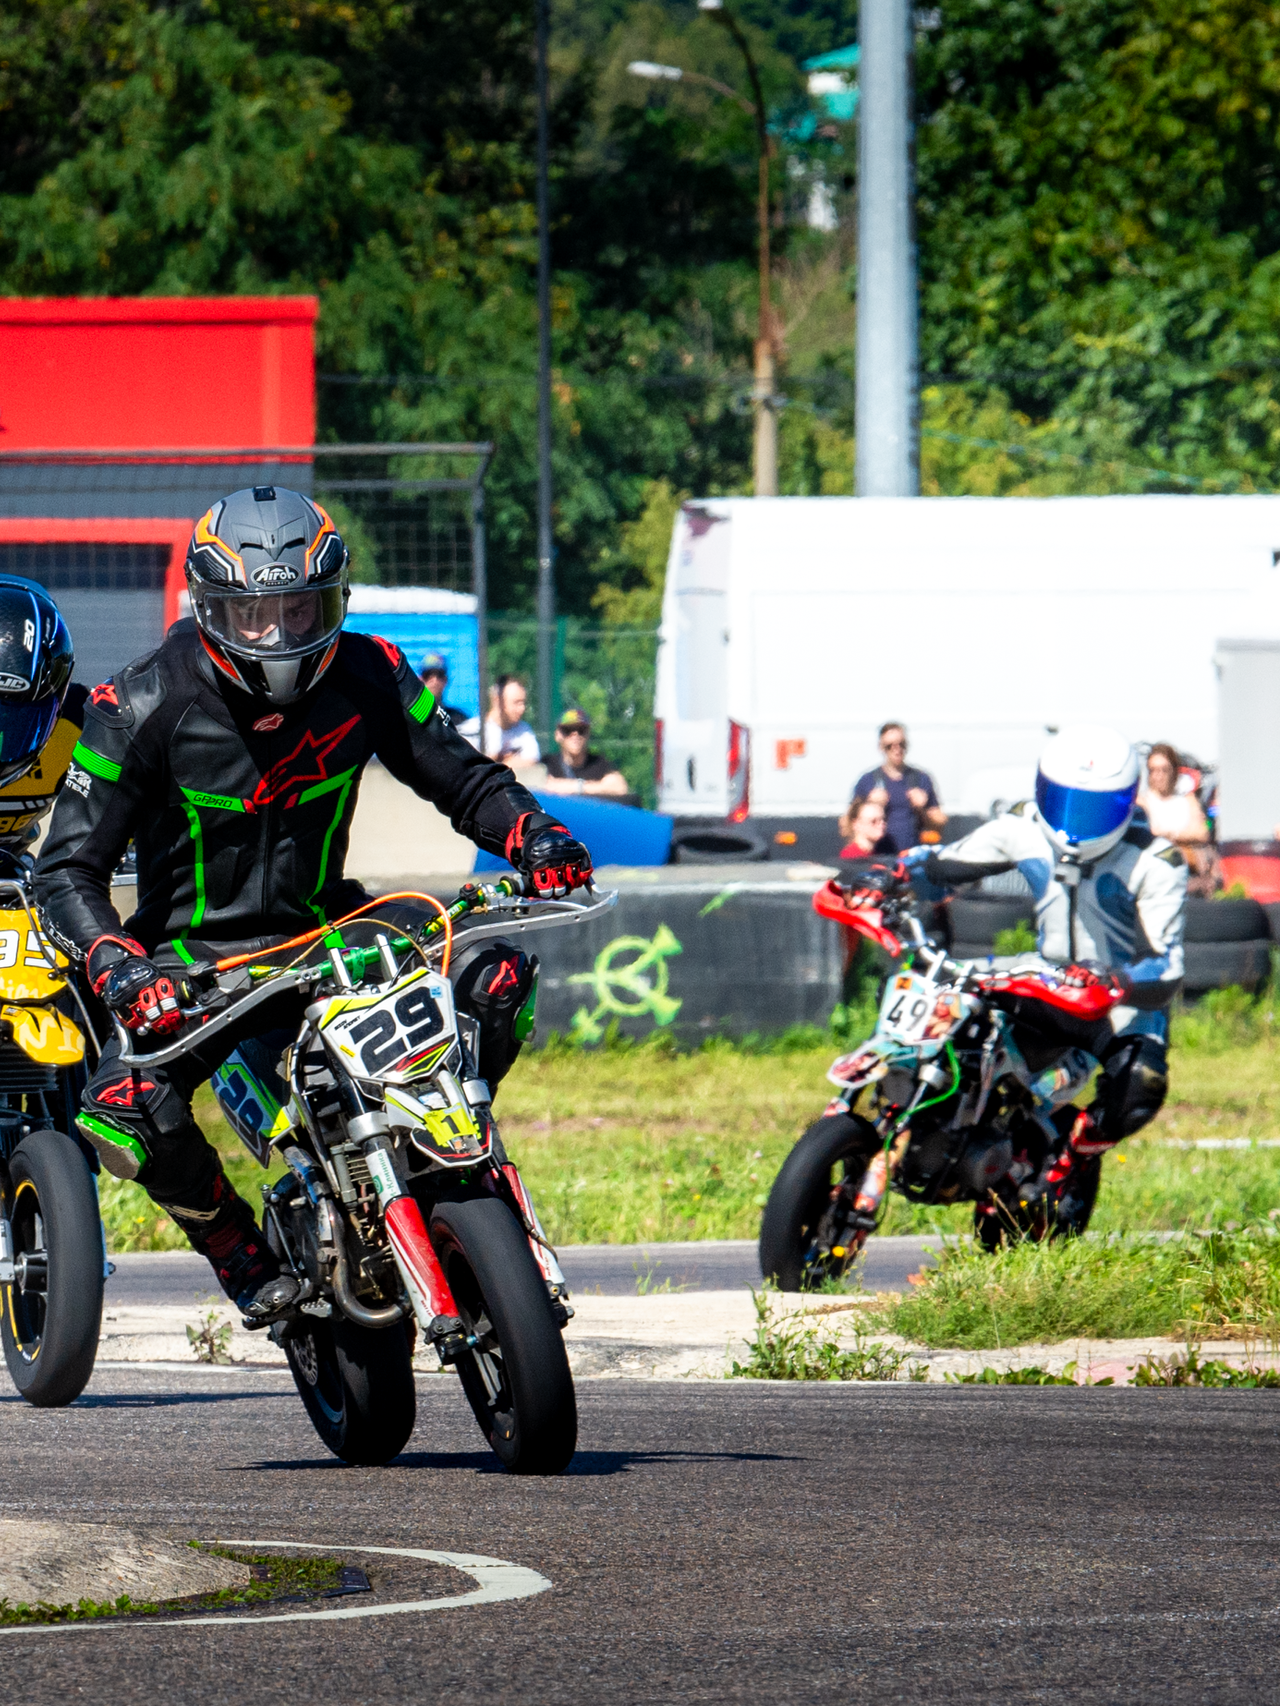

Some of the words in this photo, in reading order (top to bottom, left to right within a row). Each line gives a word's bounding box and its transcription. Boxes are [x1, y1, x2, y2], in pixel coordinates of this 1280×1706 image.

[256, 566, 296, 582] Airoh
[886, 994, 928, 1032] 49
[348, 985, 445, 1077] 29
[440, 1114, 461, 1135] 1
